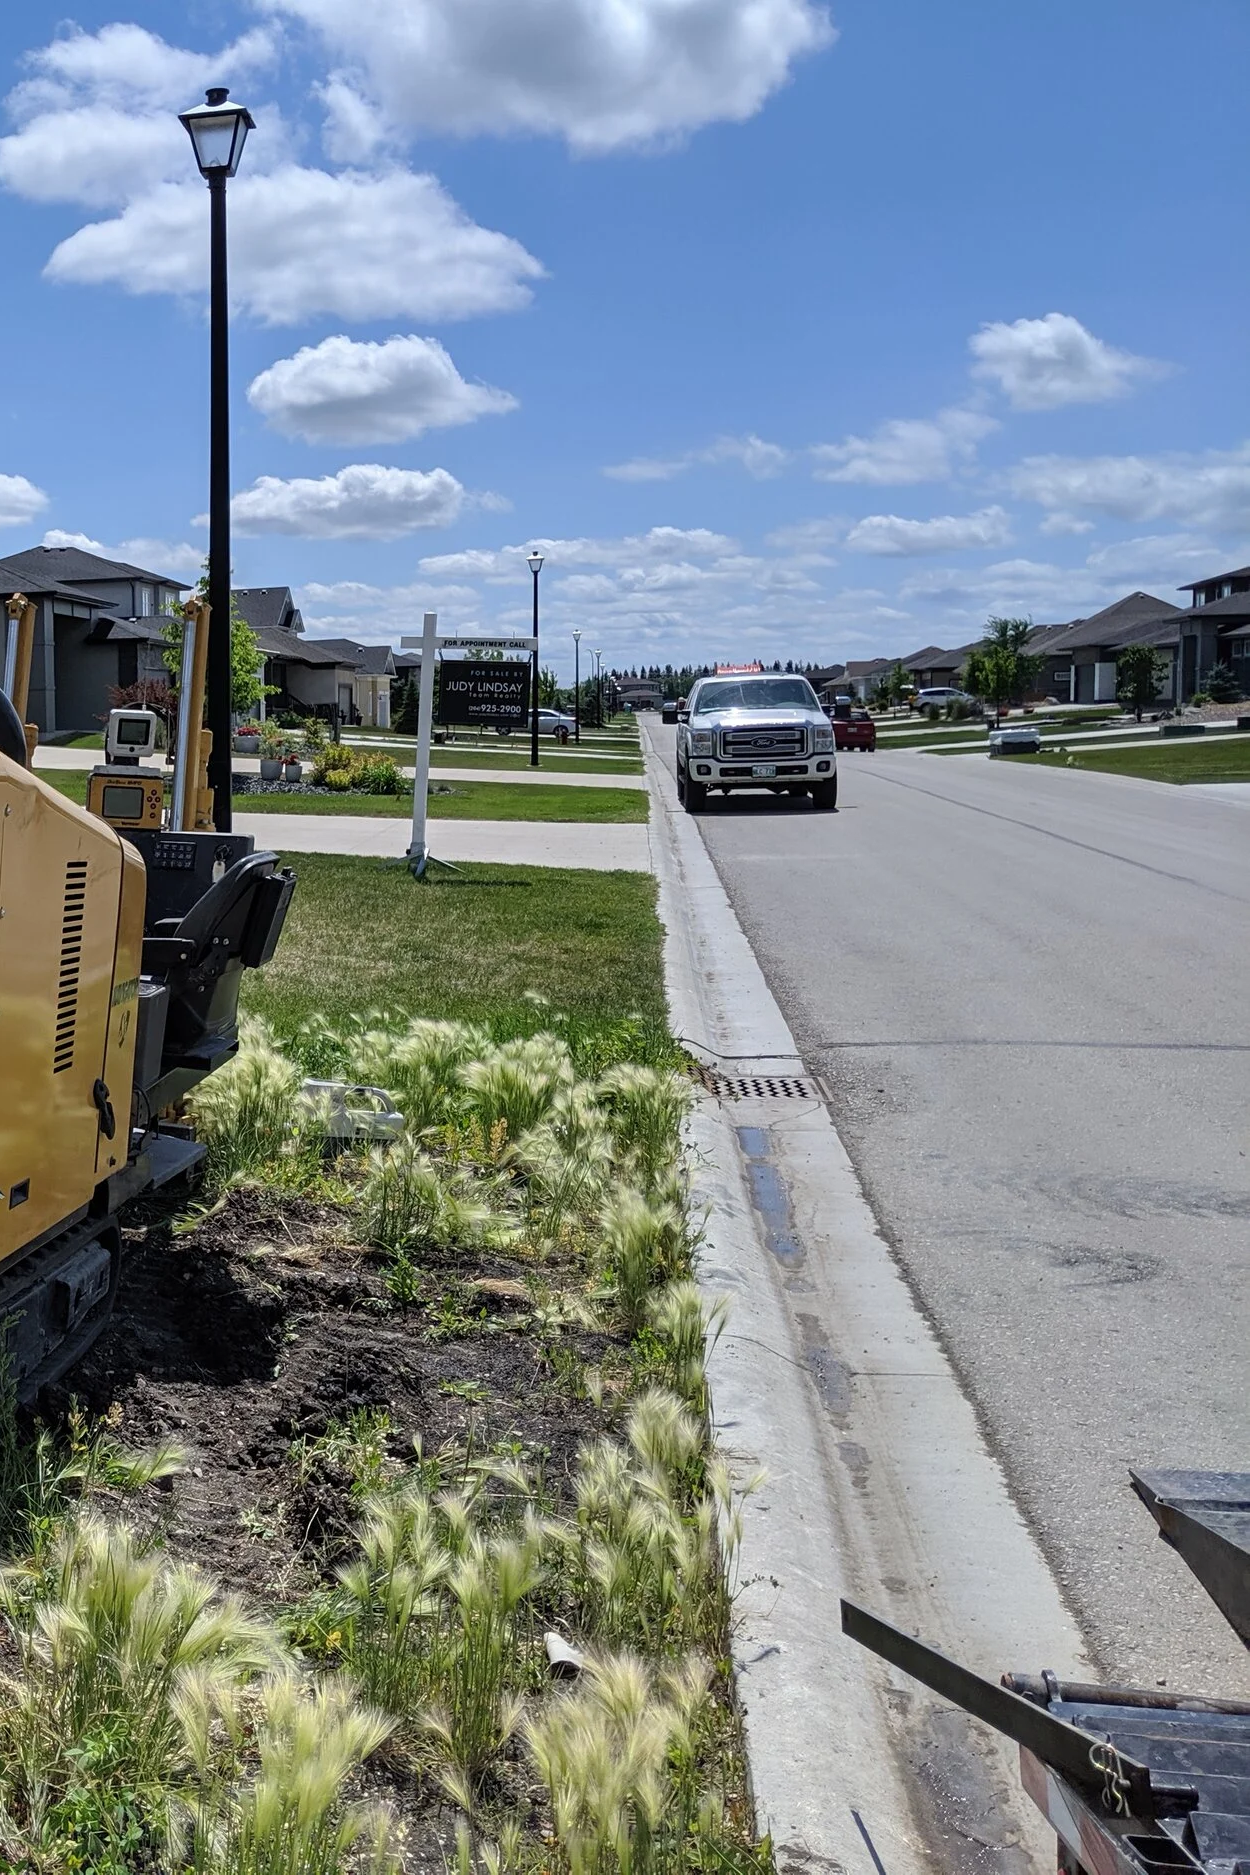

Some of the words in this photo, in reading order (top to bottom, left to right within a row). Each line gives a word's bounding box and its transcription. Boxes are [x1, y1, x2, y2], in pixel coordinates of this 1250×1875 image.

[459, 640, 507, 648] APPOINTMENT
[445, 681, 475, 692] JUDY
[477, 682, 524, 693] LINDSAY
[494, 692, 522, 700] Realty
